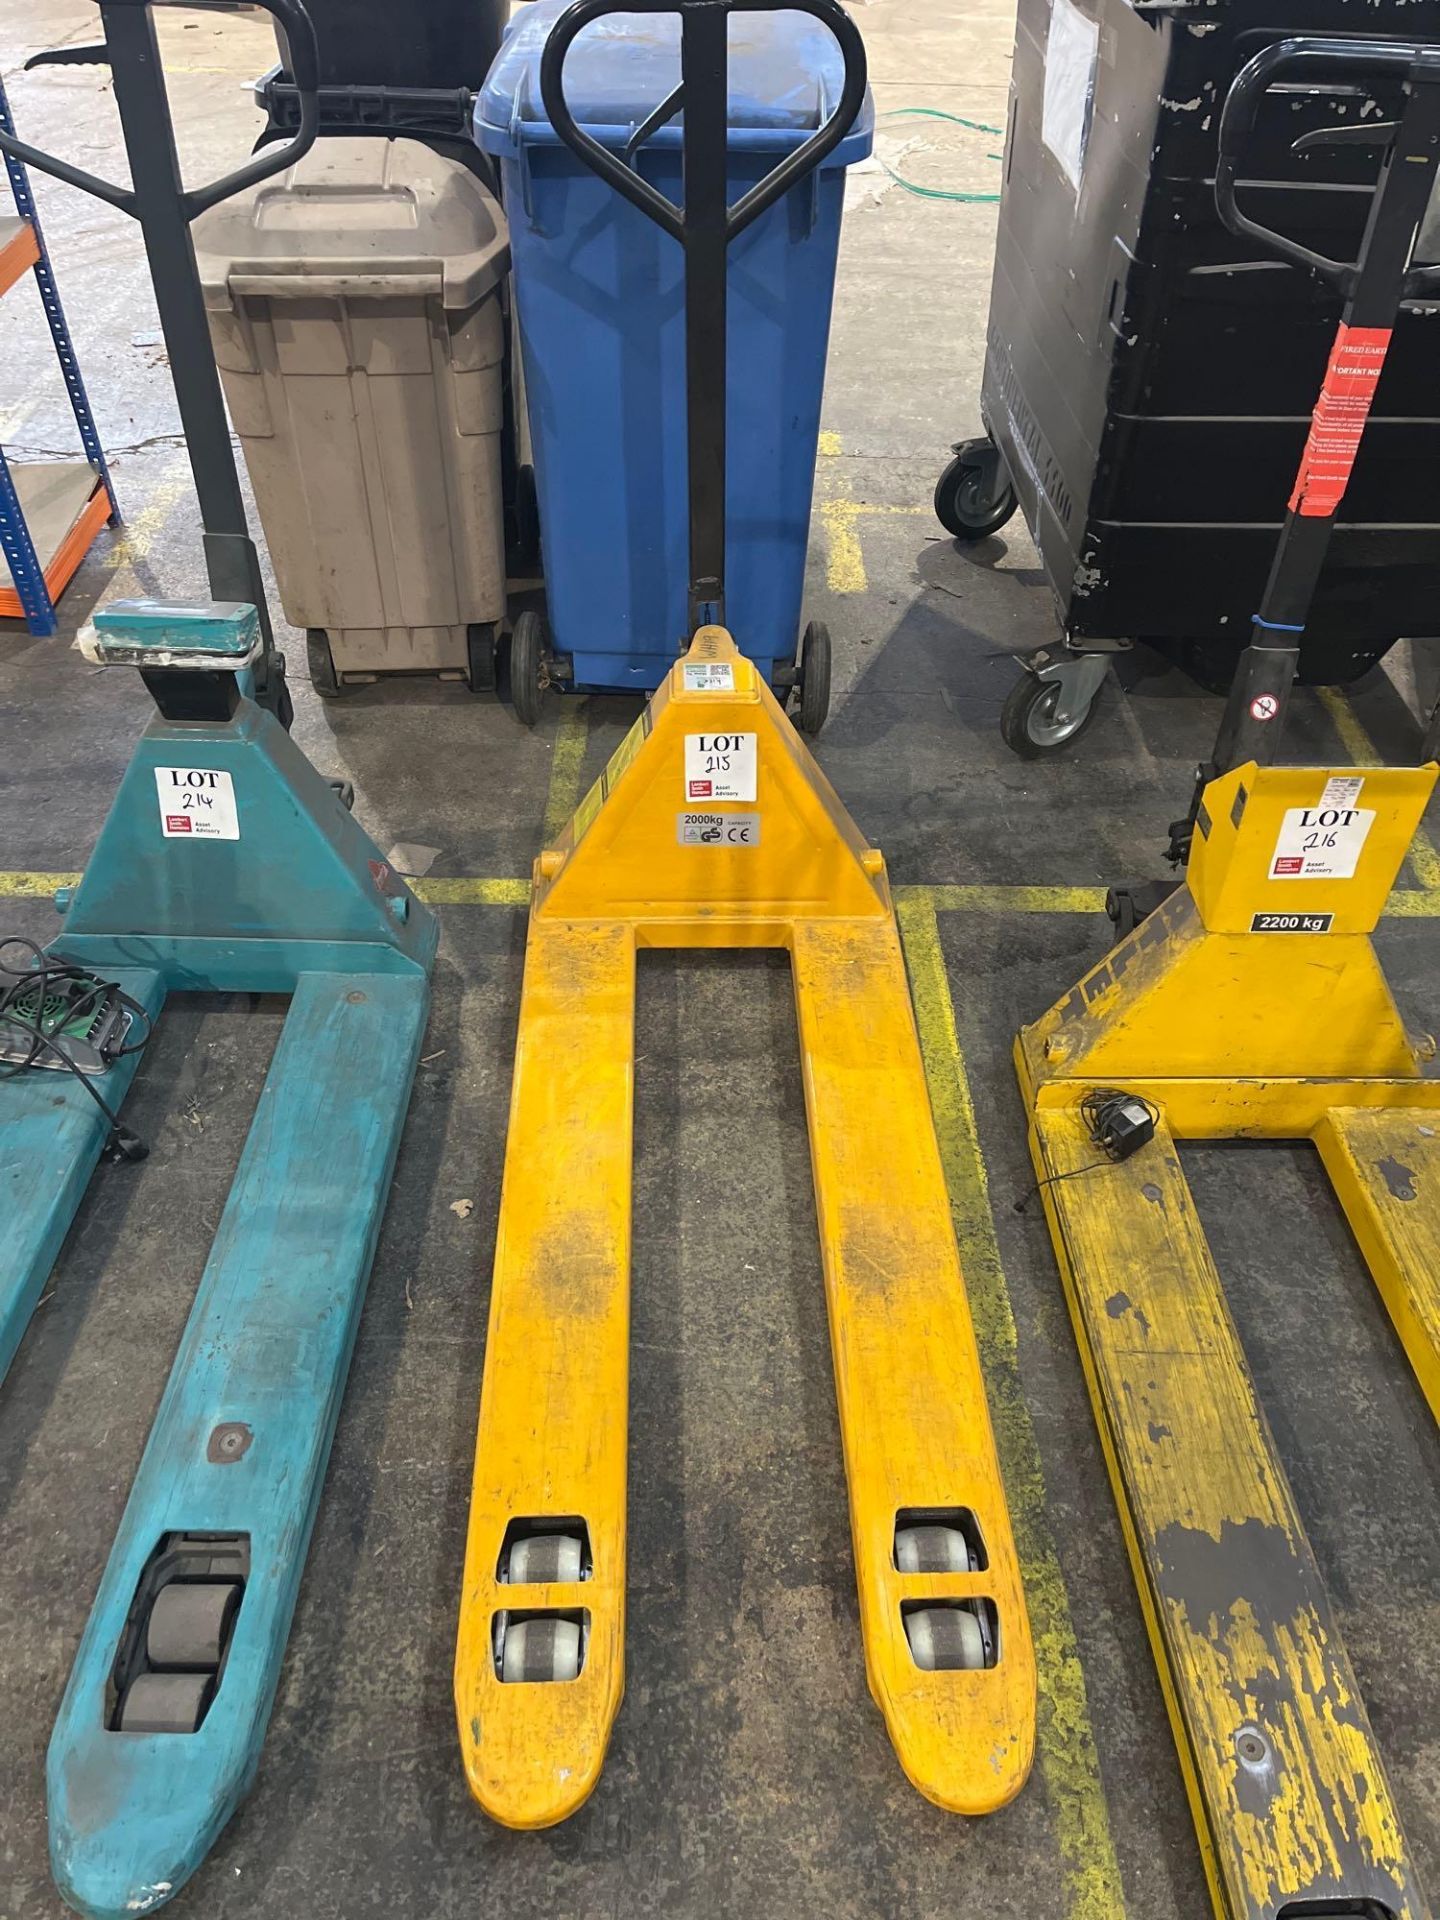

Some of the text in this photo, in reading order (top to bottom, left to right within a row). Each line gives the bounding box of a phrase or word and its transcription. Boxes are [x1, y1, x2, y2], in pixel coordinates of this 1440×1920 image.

[1340, 345, 1388, 355] FIRED EART
[1367, 368, 1381, 376] NO
[699, 735, 745, 752] LOT
[705, 754, 731, 774] 215
[170, 770, 219, 788] LOT
[182, 793, 213, 810] 214
[685, 815, 724, 827] 2000kg
[1299, 809, 1360, 828] LOT
[196, 827, 221, 835] Advisory
[727, 828, 749, 842] CE
[1302, 831, 1339, 852] 216
[1259, 916, 1324, 931] 2200 kg
